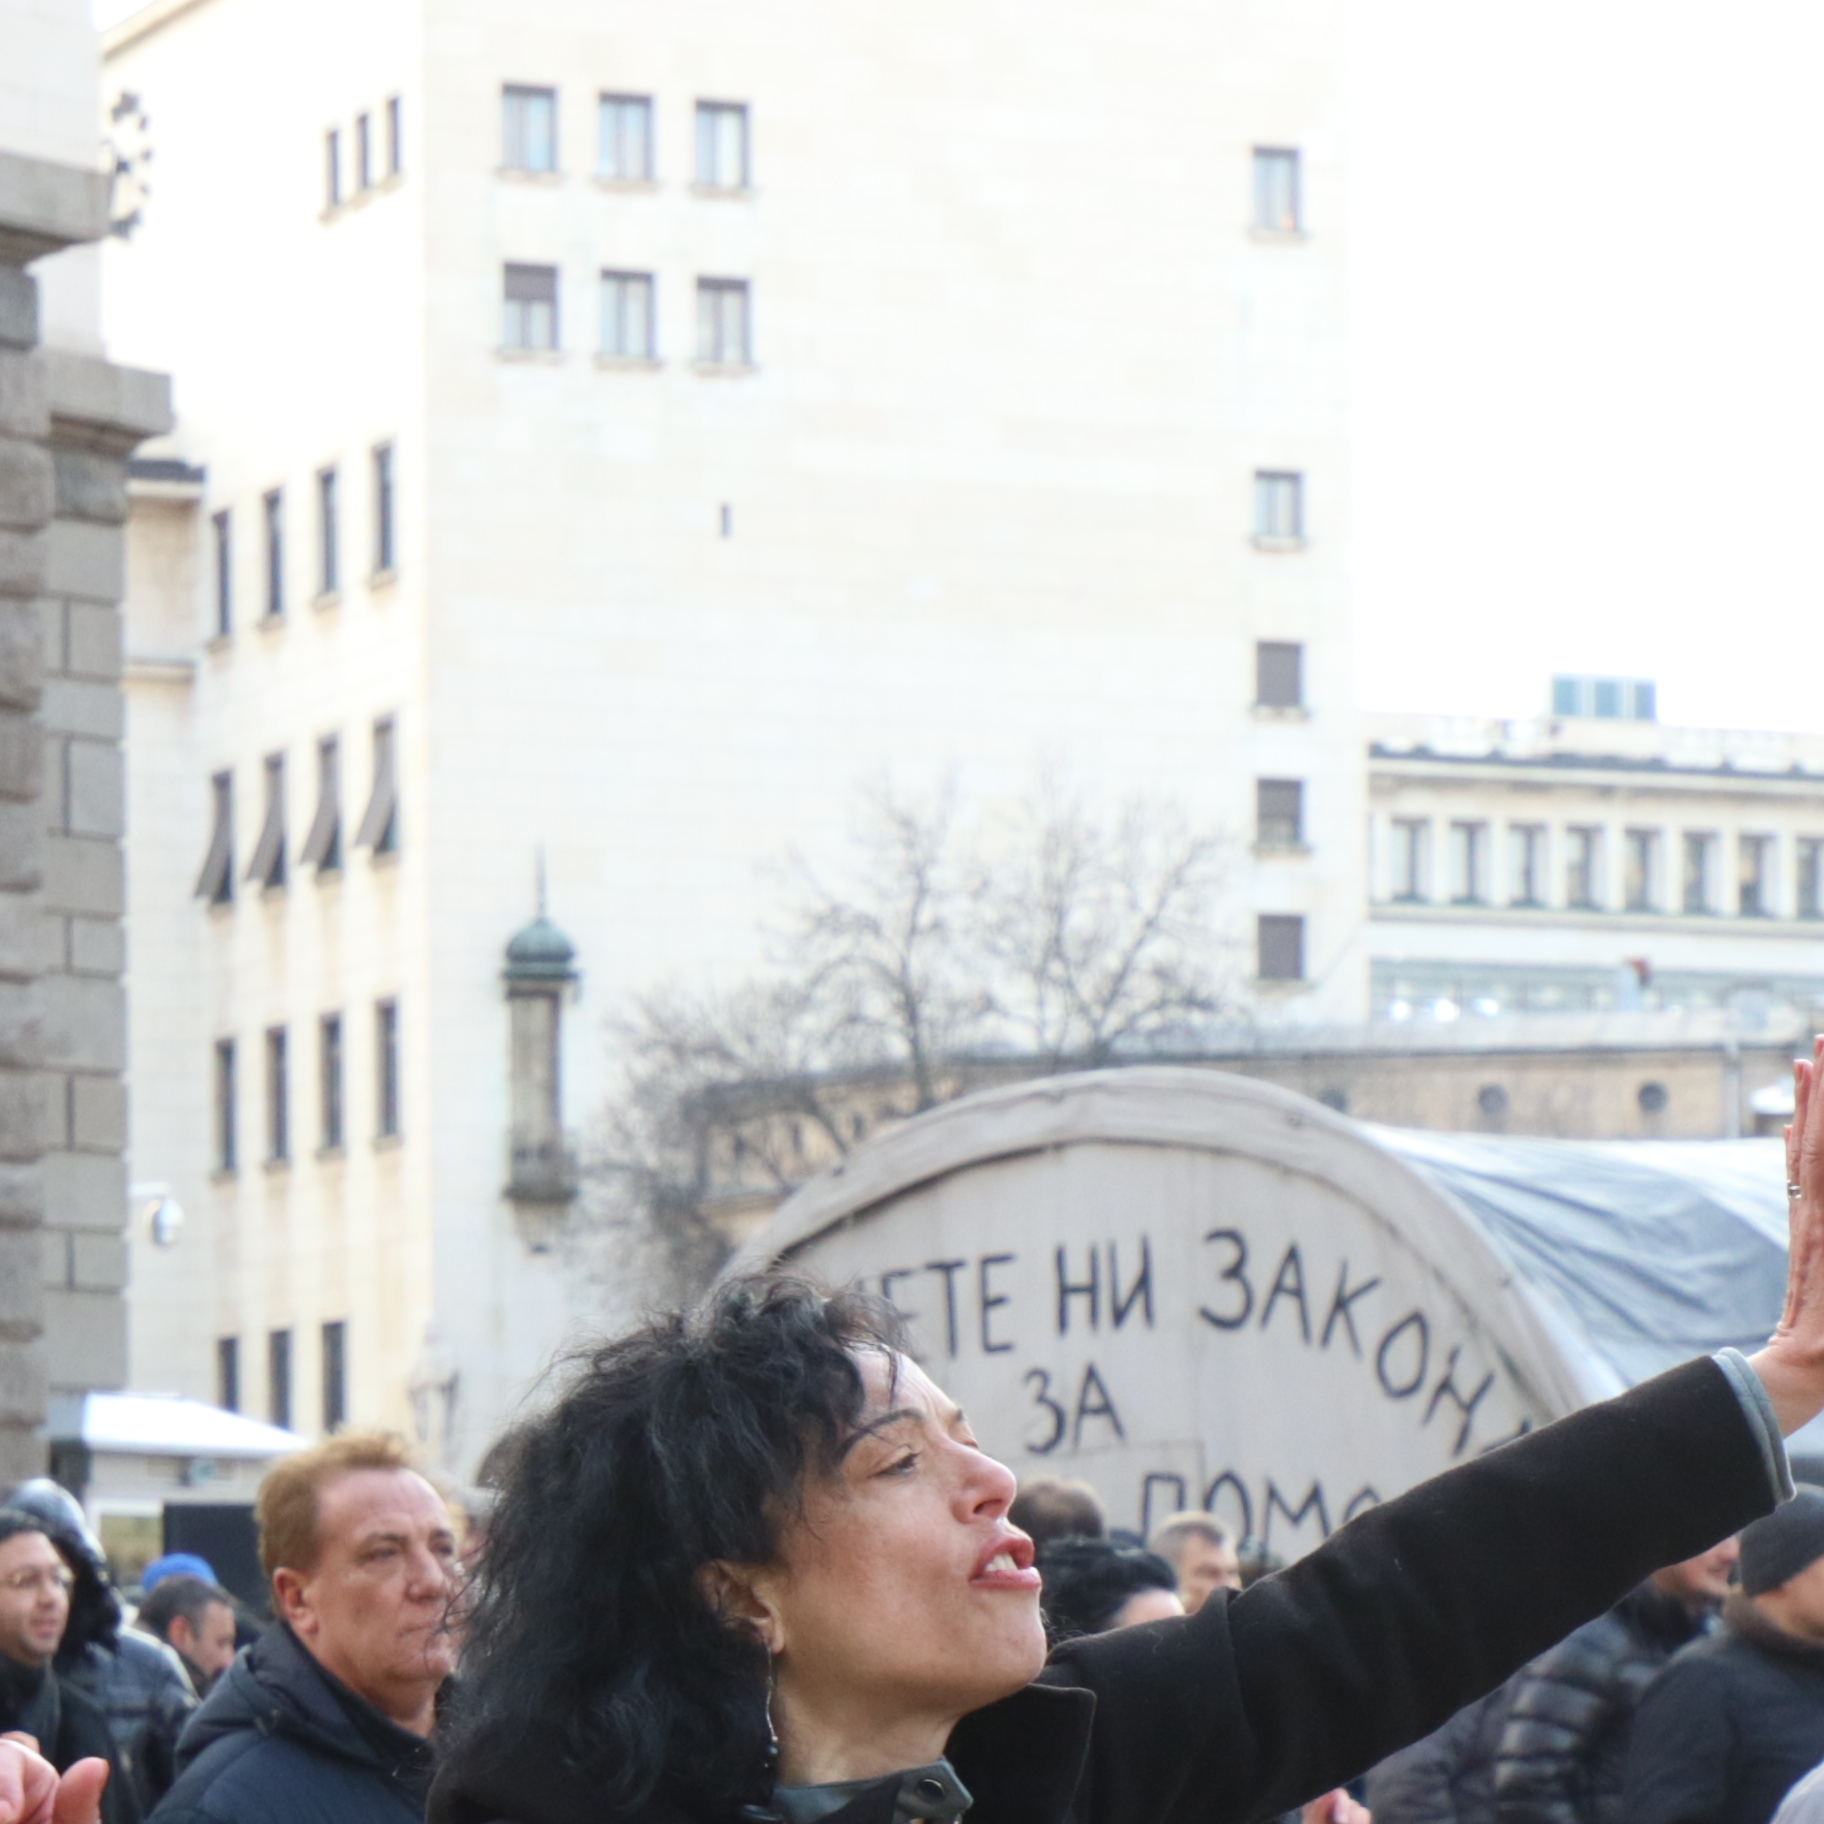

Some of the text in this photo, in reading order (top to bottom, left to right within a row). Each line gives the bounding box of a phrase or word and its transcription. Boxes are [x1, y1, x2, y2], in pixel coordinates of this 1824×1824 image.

[854, 1226, 1533, 1458] ЕТЕ НИ ЗАКОН
[1023, 1359, 1127, 1457] ЗА
